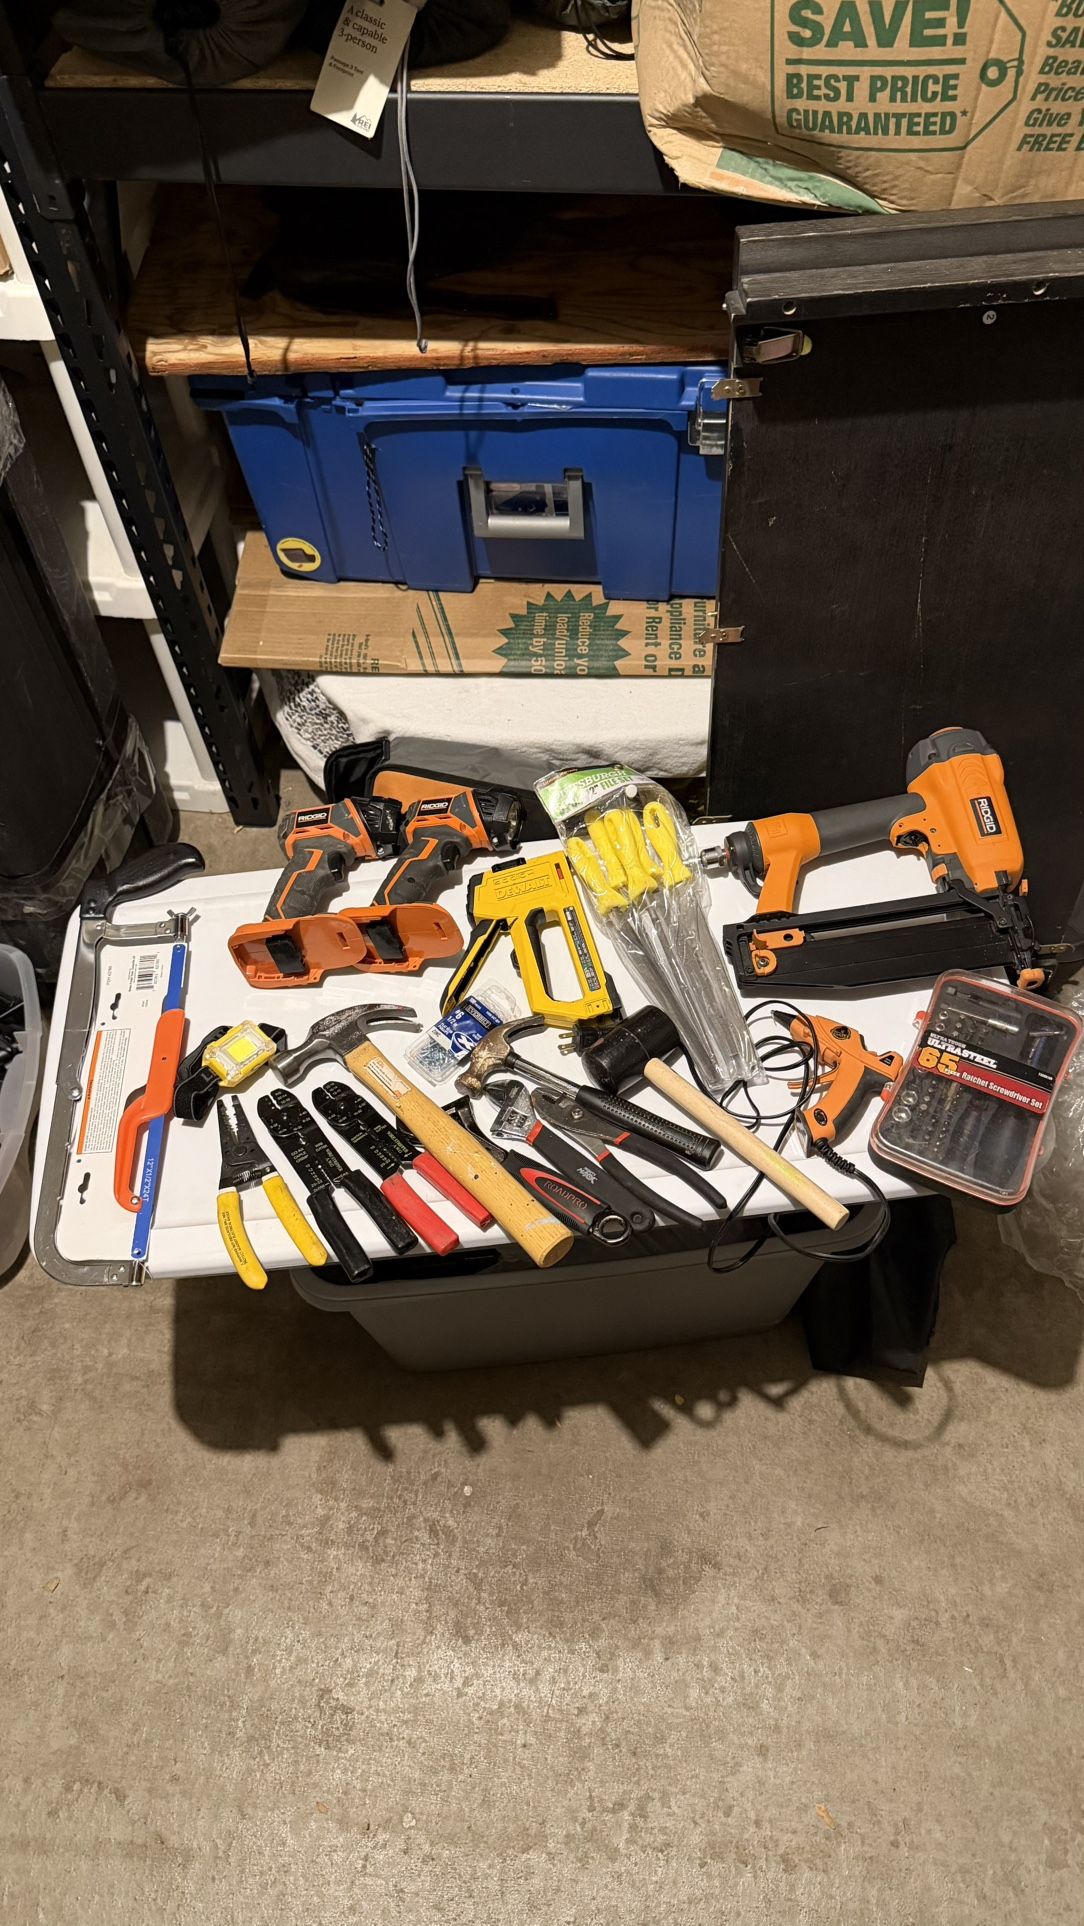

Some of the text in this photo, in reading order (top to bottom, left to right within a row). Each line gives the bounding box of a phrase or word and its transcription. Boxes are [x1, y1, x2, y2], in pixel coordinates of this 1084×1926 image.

[343, 16, 388, 44] & capable
[347, 6, 386, 29] A classic
[787, 0, 971, 48] SAVE!
[338, 27, 378, 54] 3-person
[786, 73, 960, 104] BEST PRICE
[1024, 107, 1072, 128] Give
[1016, 133, 1075, 152] FREE
[533, 612, 549, 635] time
[577, 612, 594, 654] Reduce
[645, 616, 662, 648] Rent
[666, 599, 686, 660] ppliance
[693, 600, 710, 658] urniture
[529, 638, 547, 653] by
[644, 654, 657, 672] or
[298, 812, 327, 822] RIDGID
[421, 801, 448, 811] RIDGID
[978, 798, 997, 833] RIDGID
[927, 1037, 997, 1069] ULTRASTEEL
[918, 1046, 960, 1075] 65
[962, 1072, 988, 1088] Ratchet
[988, 1080, 1031, 1104] Screwdriver
[1031, 1098, 1043, 1109] Set
[544, 1180, 588, 1210] ROADPRO
